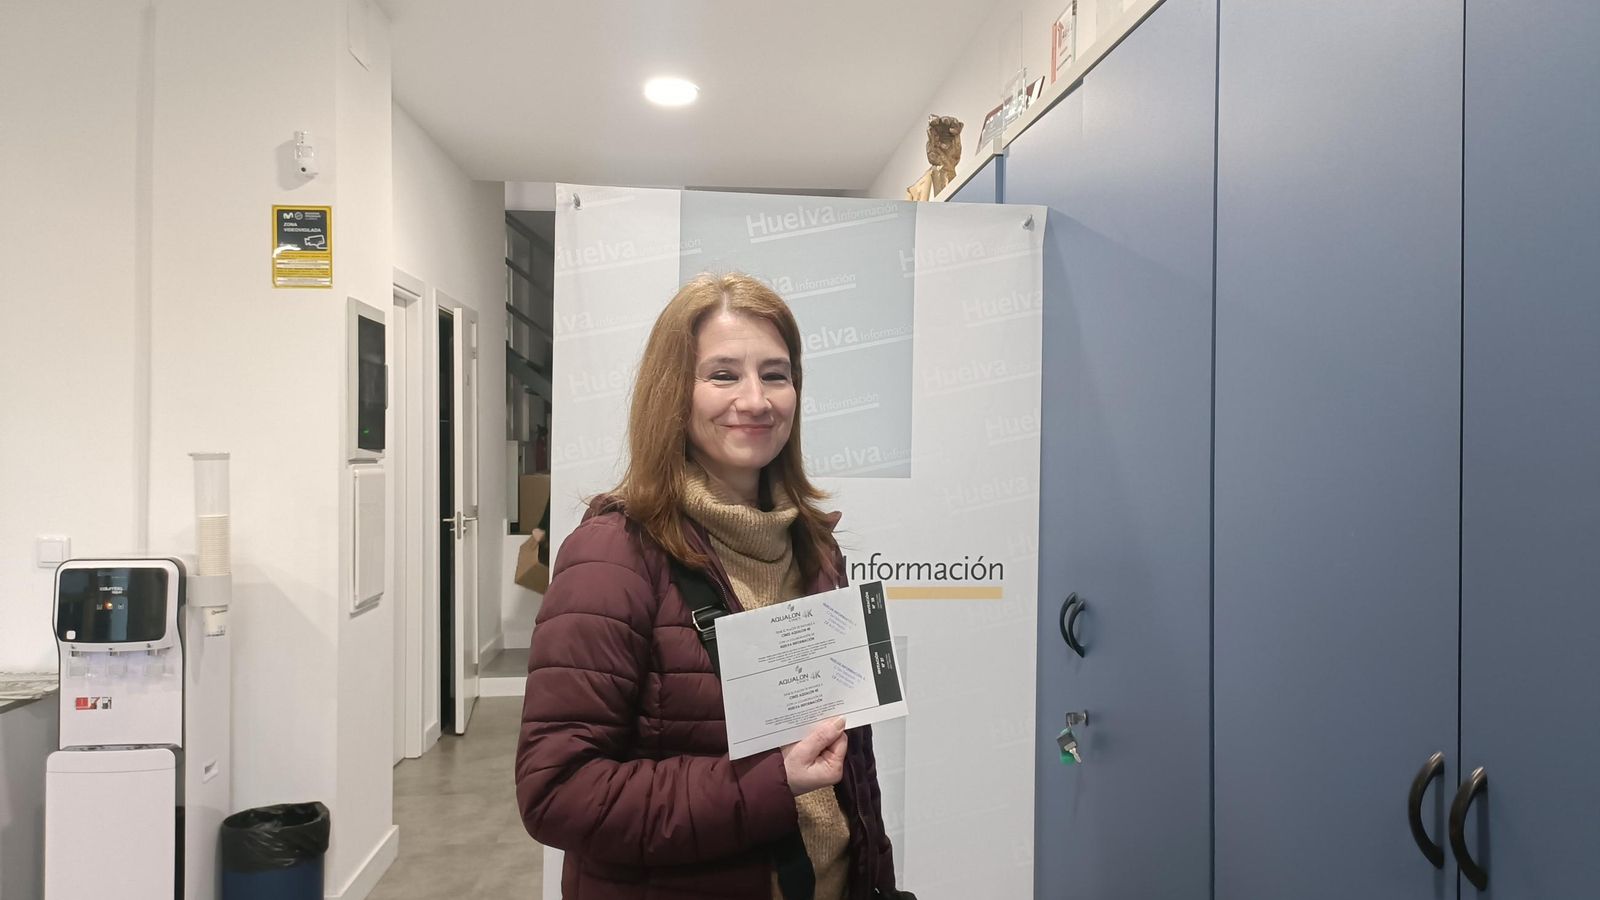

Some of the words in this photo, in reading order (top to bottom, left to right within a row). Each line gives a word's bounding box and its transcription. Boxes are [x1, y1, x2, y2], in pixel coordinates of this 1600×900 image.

[746, 205, 835, 237] Huelva
[837, 202, 899, 222] Información
[899, 240, 985, 270] Huelva
[796, 273, 856, 291] Información
[555, 311, 595, 334] lva
[802, 326, 859, 350] elva
[568, 371, 624, 395] Hue
[921, 359, 1006, 389] Huelva
[819, 392, 880, 412] Información
[771, 611, 801, 623] AQUALON
[778, 673, 809, 686] AQUALON
